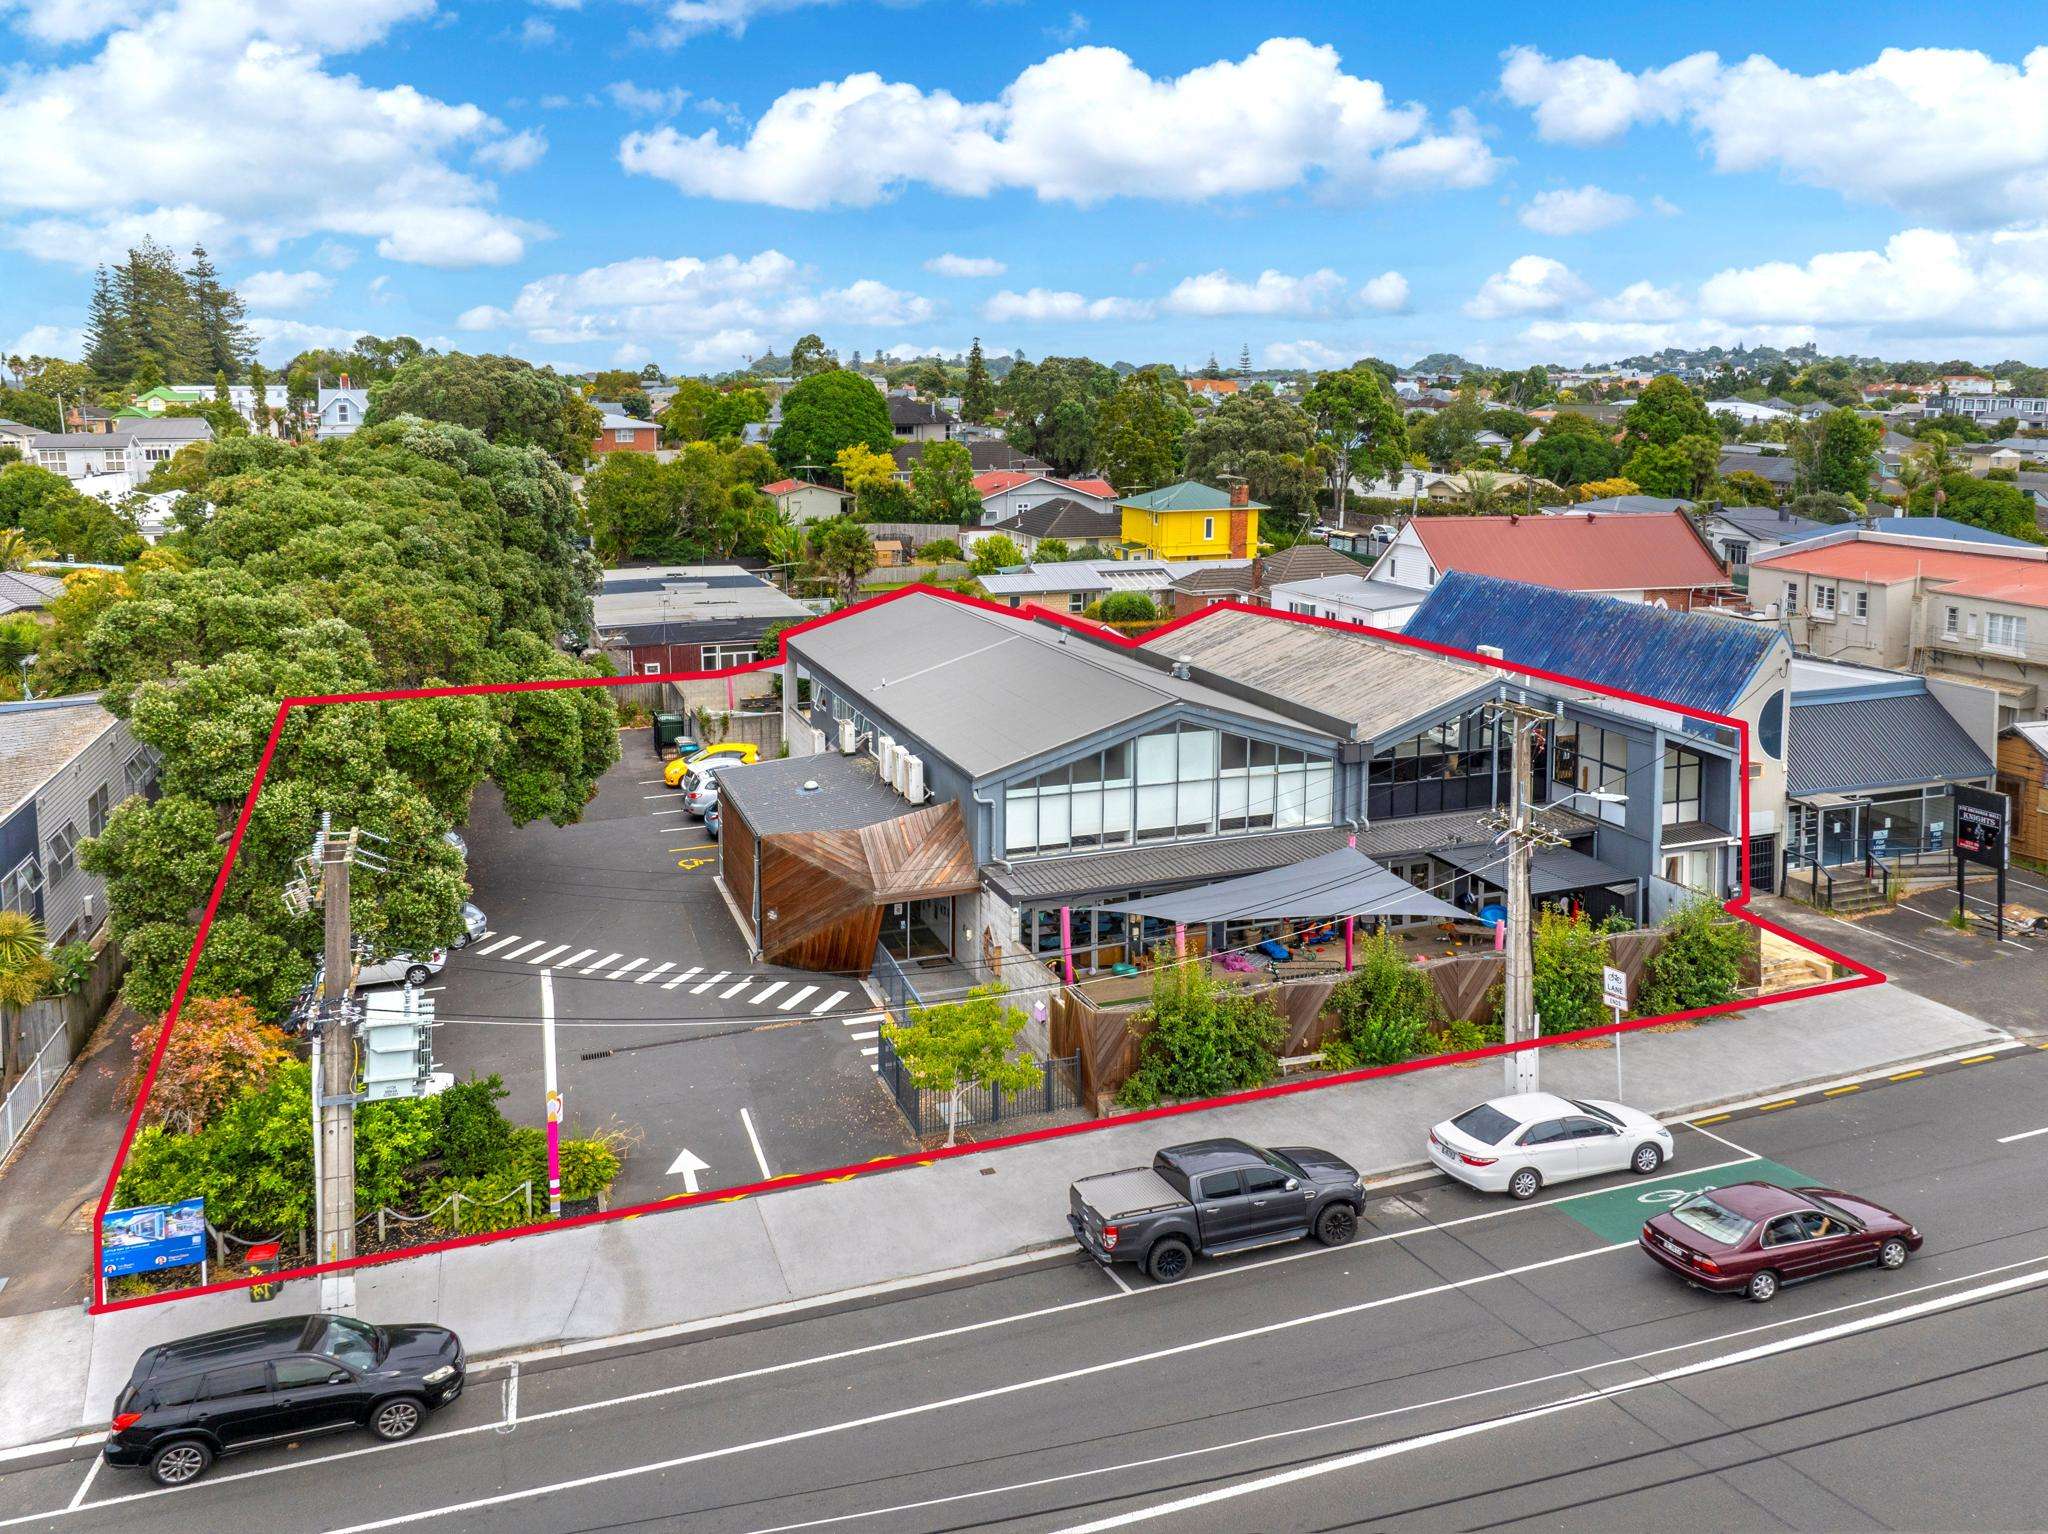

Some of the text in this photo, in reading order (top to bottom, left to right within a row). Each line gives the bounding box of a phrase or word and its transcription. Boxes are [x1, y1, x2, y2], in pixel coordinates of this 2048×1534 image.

[1963, 812, 1995, 826] KNIGHTS
[1607, 984, 1623, 994] LANE
[1609, 998, 1621, 1006] ENDS
